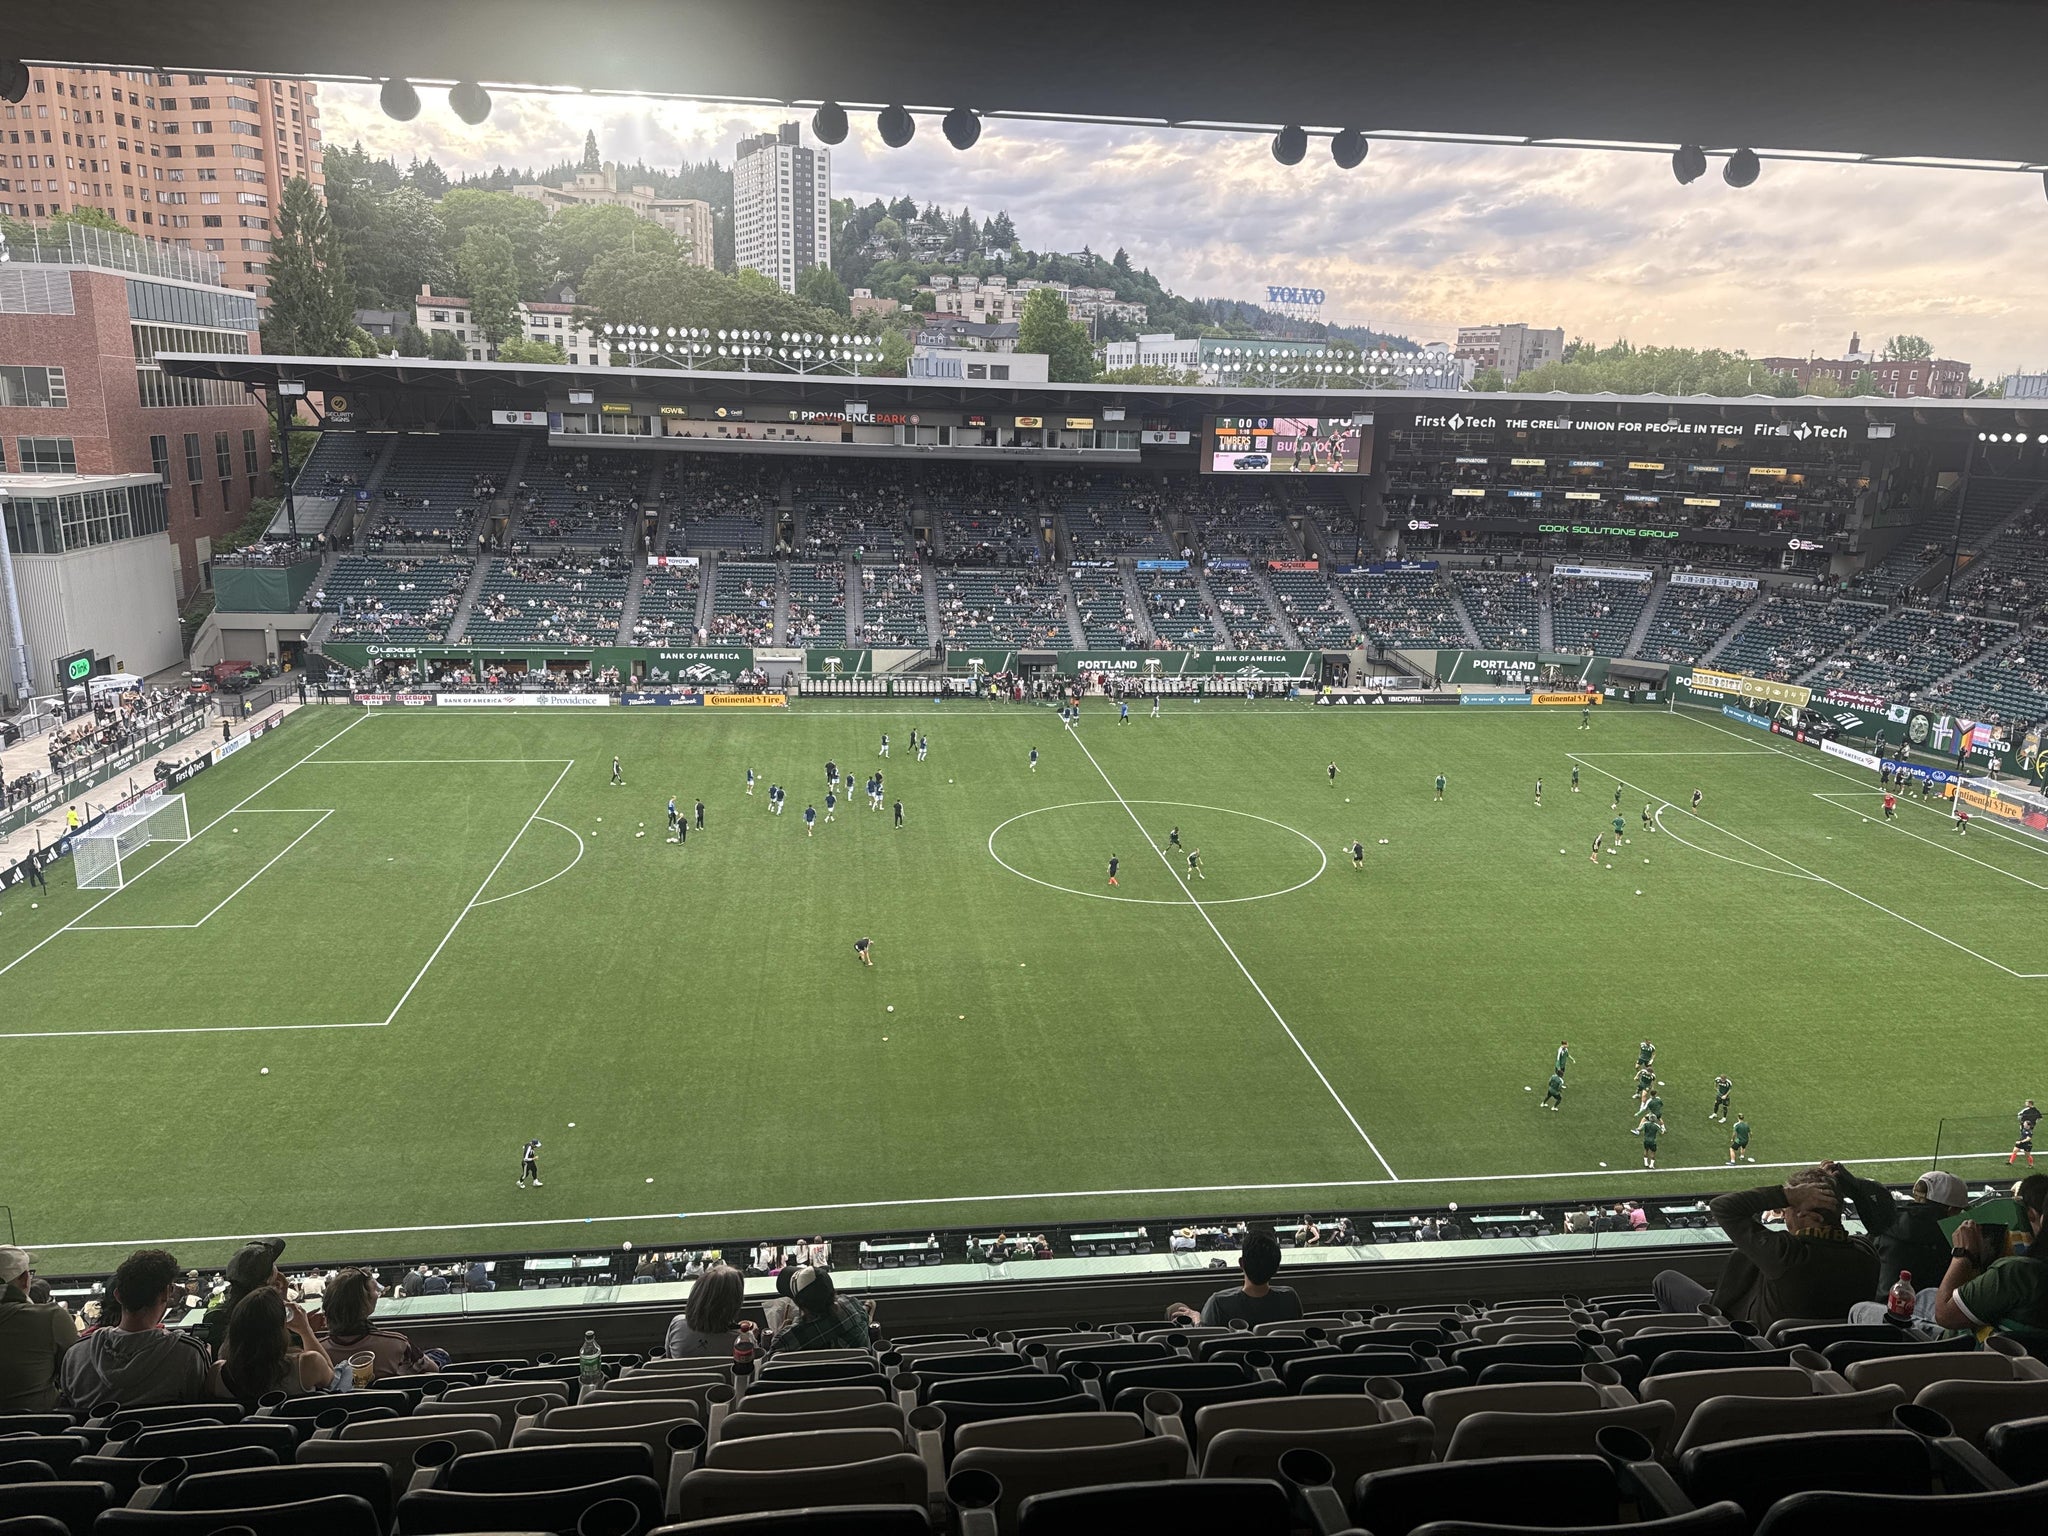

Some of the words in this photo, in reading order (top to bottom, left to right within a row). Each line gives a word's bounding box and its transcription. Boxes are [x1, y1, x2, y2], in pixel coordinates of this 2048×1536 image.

[1267, 286, 1326, 304] VOLVO
[1415, 415, 1446, 427] First
[1465, 416, 1496, 428] Tech
[1506, 419, 1528, 428] THE
[1530, 420, 1573, 429] CRET
[1575, 421, 1616, 431] UNION
[1617, 422, 1642, 431] FOR
[1693, 425, 1707, 433] IN
[1709, 425, 1743, 435] TECH
[1754, 424, 1786, 436] Firs
[1813, 425, 1848, 438] Tech
[1219, 436, 1251, 445] TIMBERS
[1572, 526, 1637, 536] SOLUTIONS
[1639, 529, 1679, 539] GROUP
[1077, 660, 1138, 669] PORTLAND
[1473, 660, 1536, 670] PORTLAND
[1538, 694, 1577, 703] Continental
[1688, 687, 1725, 699] TIMBERS
[551, 695, 597, 704] Providence
[711, 695, 755, 705] Continental
[762, 695, 780, 703] Tire
[1811, 695, 1835, 706] BANK
[1837, 699, 1848, 708] OF
[1849, 701, 1891, 716] AMERICA
[1780, 726, 1794, 737] TOYOTA
[1804, 735, 1820, 746] TOYOTA
[1843, 750, 1865, 762] AMERICA
[1972, 746, 1995, 757] BERS
[114, 754, 133, 768] PORTLAND
[175, 769, 189, 782] First
[193, 760, 205, 771] Tech
[31, 793, 56, 812] PORTLAND
[1952, 787, 1991, 807] Continental
[1997, 800, 2017, 816] Tire
